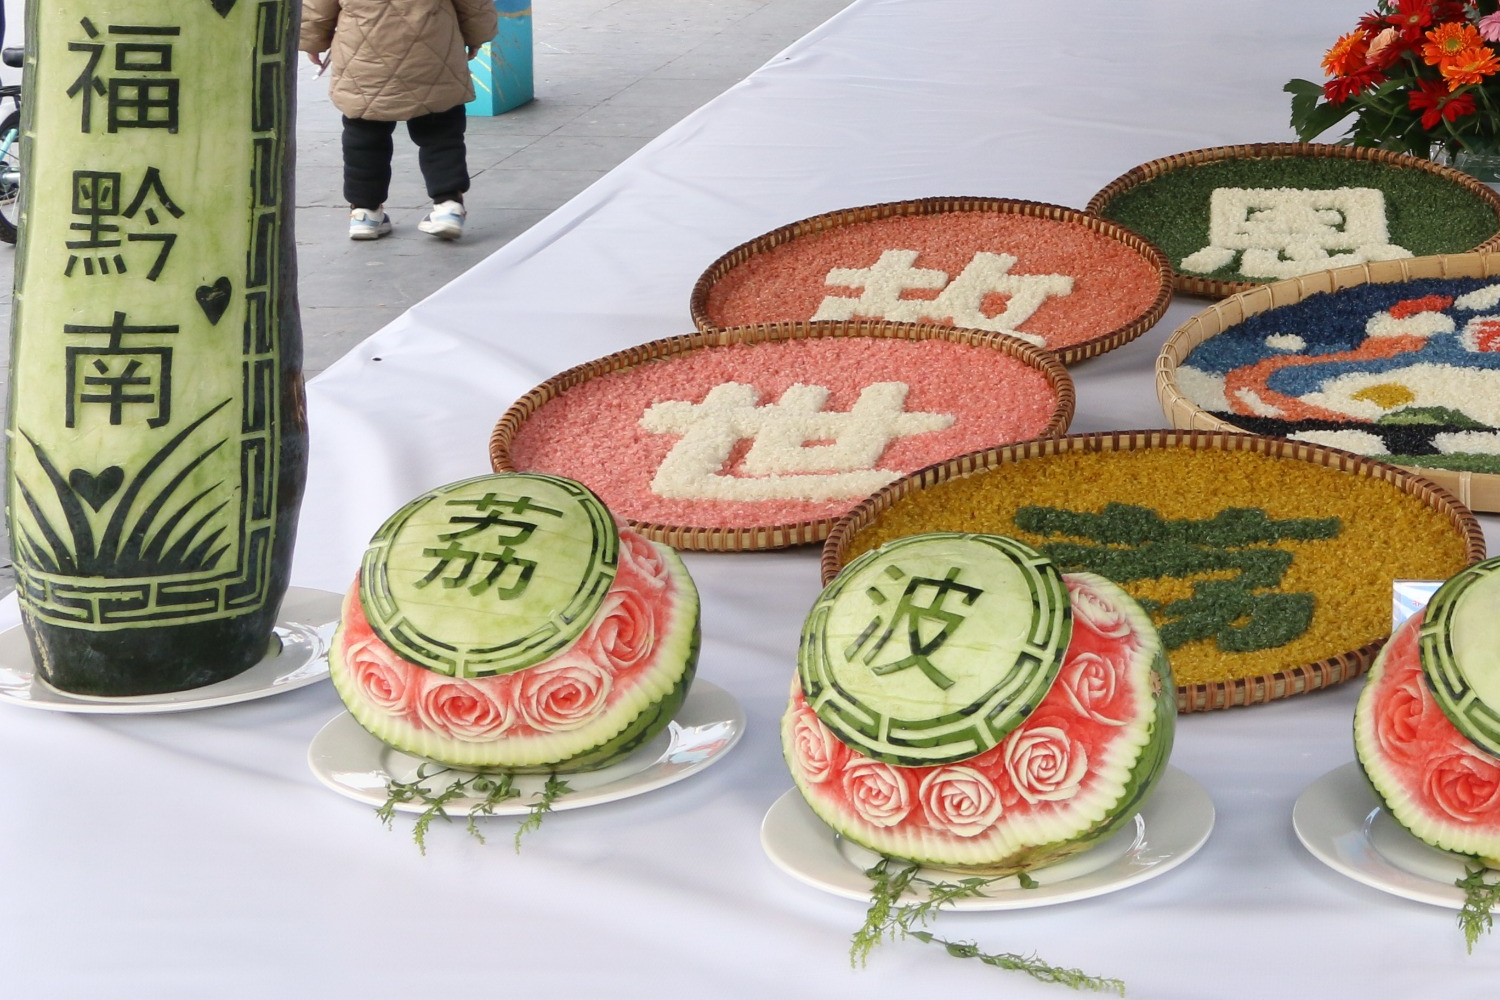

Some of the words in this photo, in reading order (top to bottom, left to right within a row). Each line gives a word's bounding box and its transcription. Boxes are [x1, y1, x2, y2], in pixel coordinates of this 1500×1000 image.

[1180, 185, 1415, 282] 恩
[638, 380, 957, 501] 世
[412, 491, 564, 602] 荔
[844, 563, 985, 691] 波
